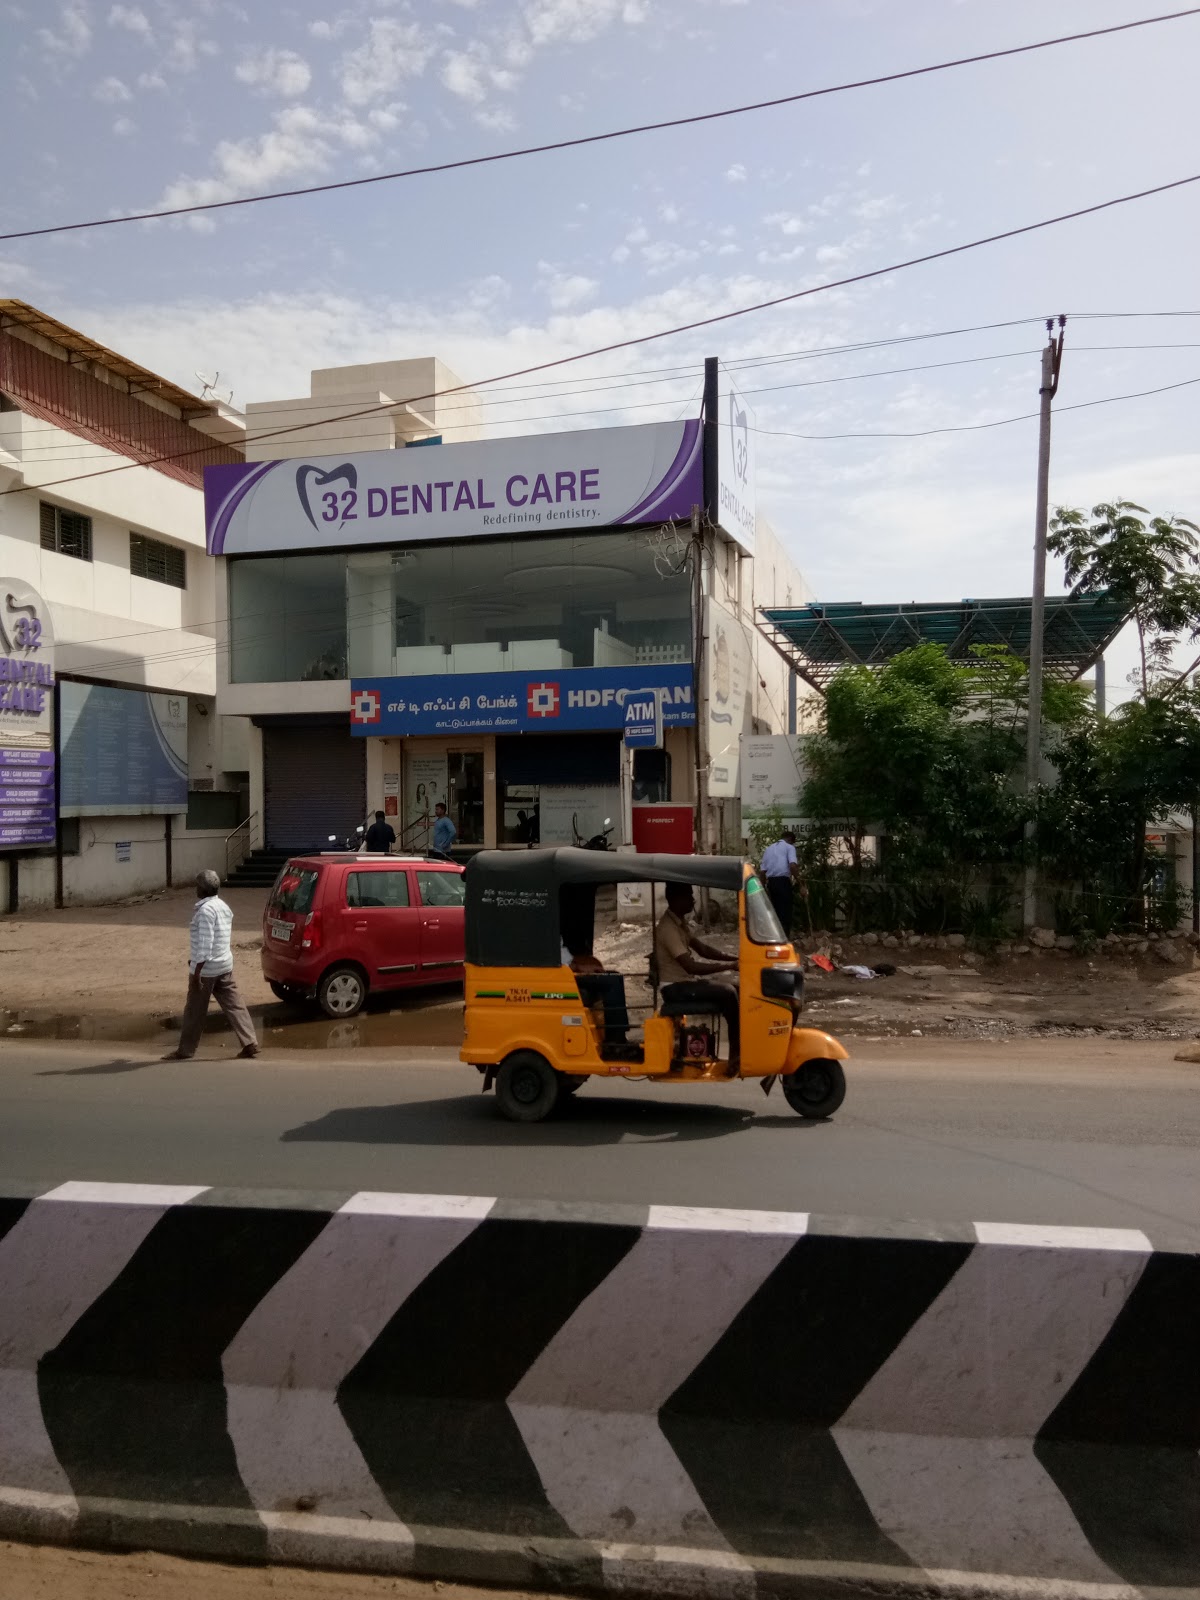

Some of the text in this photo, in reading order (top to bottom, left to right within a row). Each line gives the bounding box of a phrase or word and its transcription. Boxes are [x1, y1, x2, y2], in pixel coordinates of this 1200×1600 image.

[736, 438, 748, 485] 32
[321, 468, 600, 522] 32 DENTAL CARE
[720, 482, 755, 535] DENTAL CARE
[483, 508, 600, 526] Redefining dentistry.
[13, 617, 42, 650] 32
[0, 657, 55, 686] ENTAL
[476, 694, 518, 709] பேங்க்
[567, 688, 628, 707] HDFC
[625, 702, 655, 721] ATM
